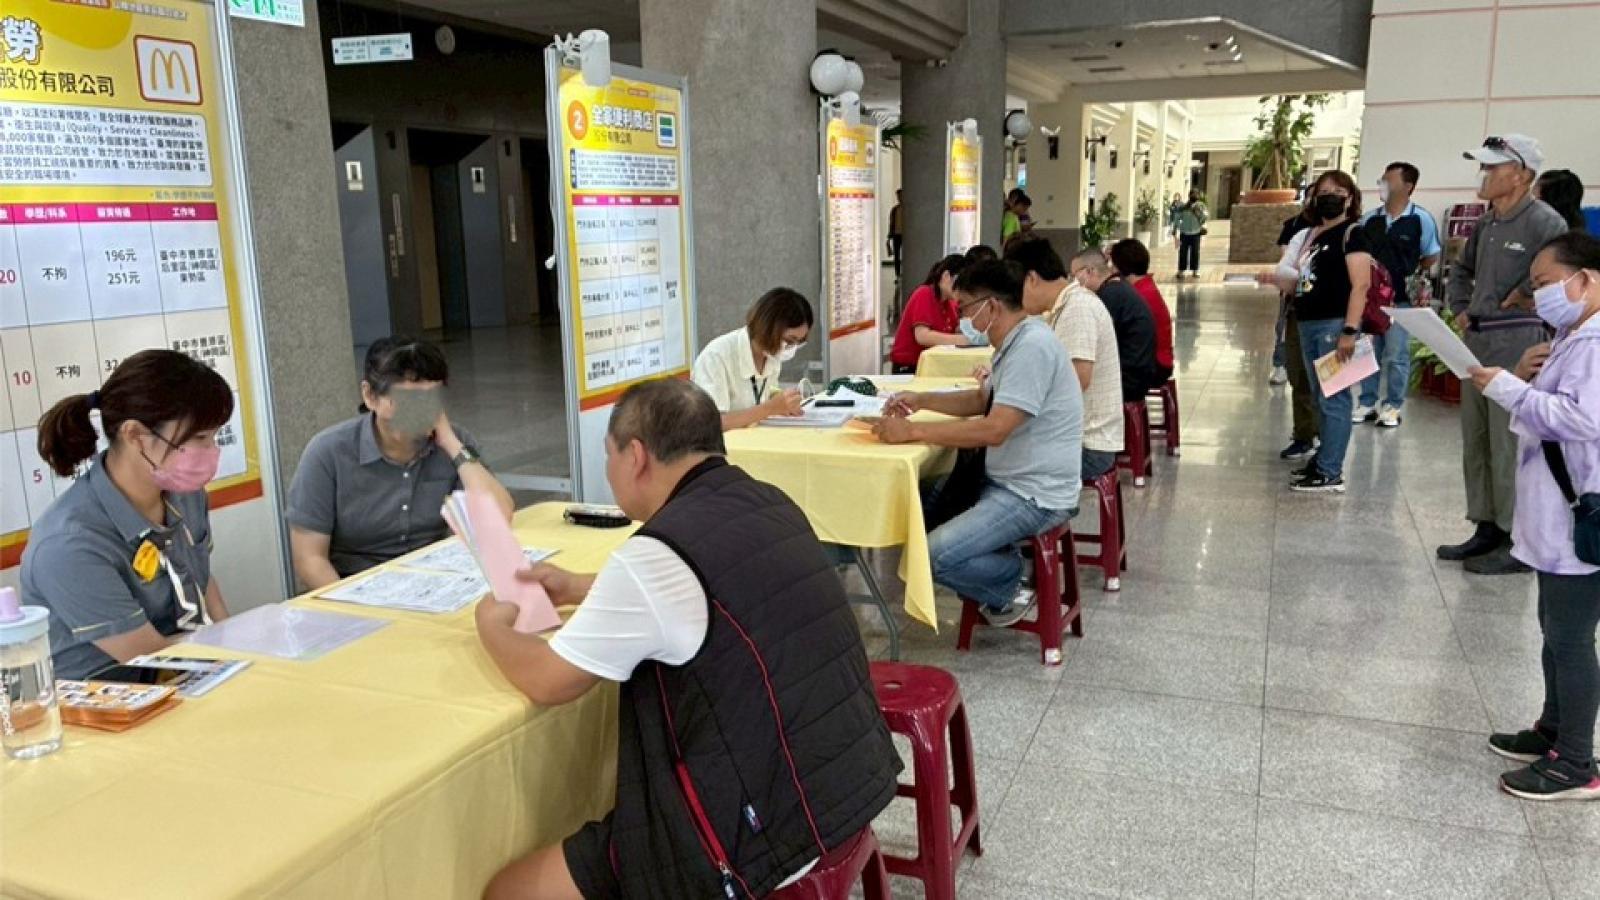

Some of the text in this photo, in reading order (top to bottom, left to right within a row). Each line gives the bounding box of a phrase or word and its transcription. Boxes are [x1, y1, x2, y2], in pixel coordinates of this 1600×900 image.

[0, 16, 43, 64] 勞
[0, 67, 114, 98] 股份有限公司
[573, 110, 584, 130] 2
[105, 249, 137, 263] 196元
[0, 269, 16, 283] 20
[42, 267, 68, 281] 不拘
[108, 272, 141, 285] 251元
[13, 371, 31, 386] 10
[56, 365, 81, 379] 不拘
[33, 469, 43, 483] 5
